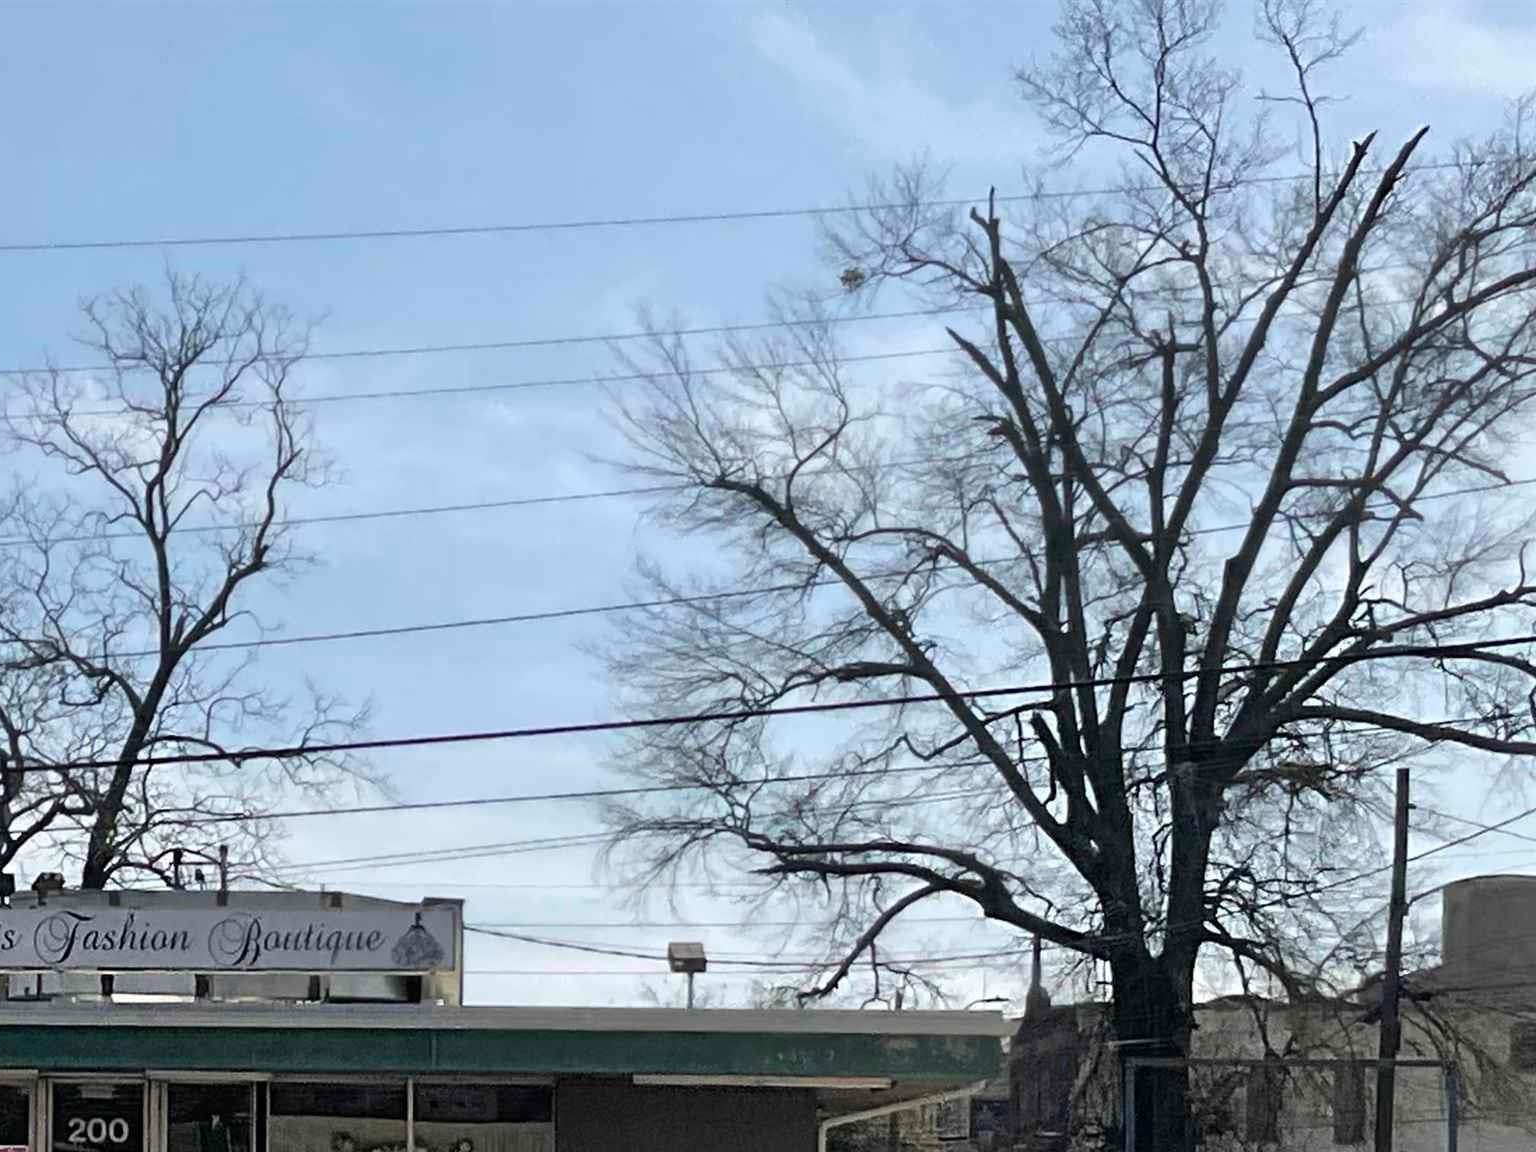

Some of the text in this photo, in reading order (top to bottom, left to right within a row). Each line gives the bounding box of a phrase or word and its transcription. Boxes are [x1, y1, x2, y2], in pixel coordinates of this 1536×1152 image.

[33, 909, 191, 965] Fashion
[208, 912, 386, 967] Boutique
[68, 1117, 129, 1143] 200
